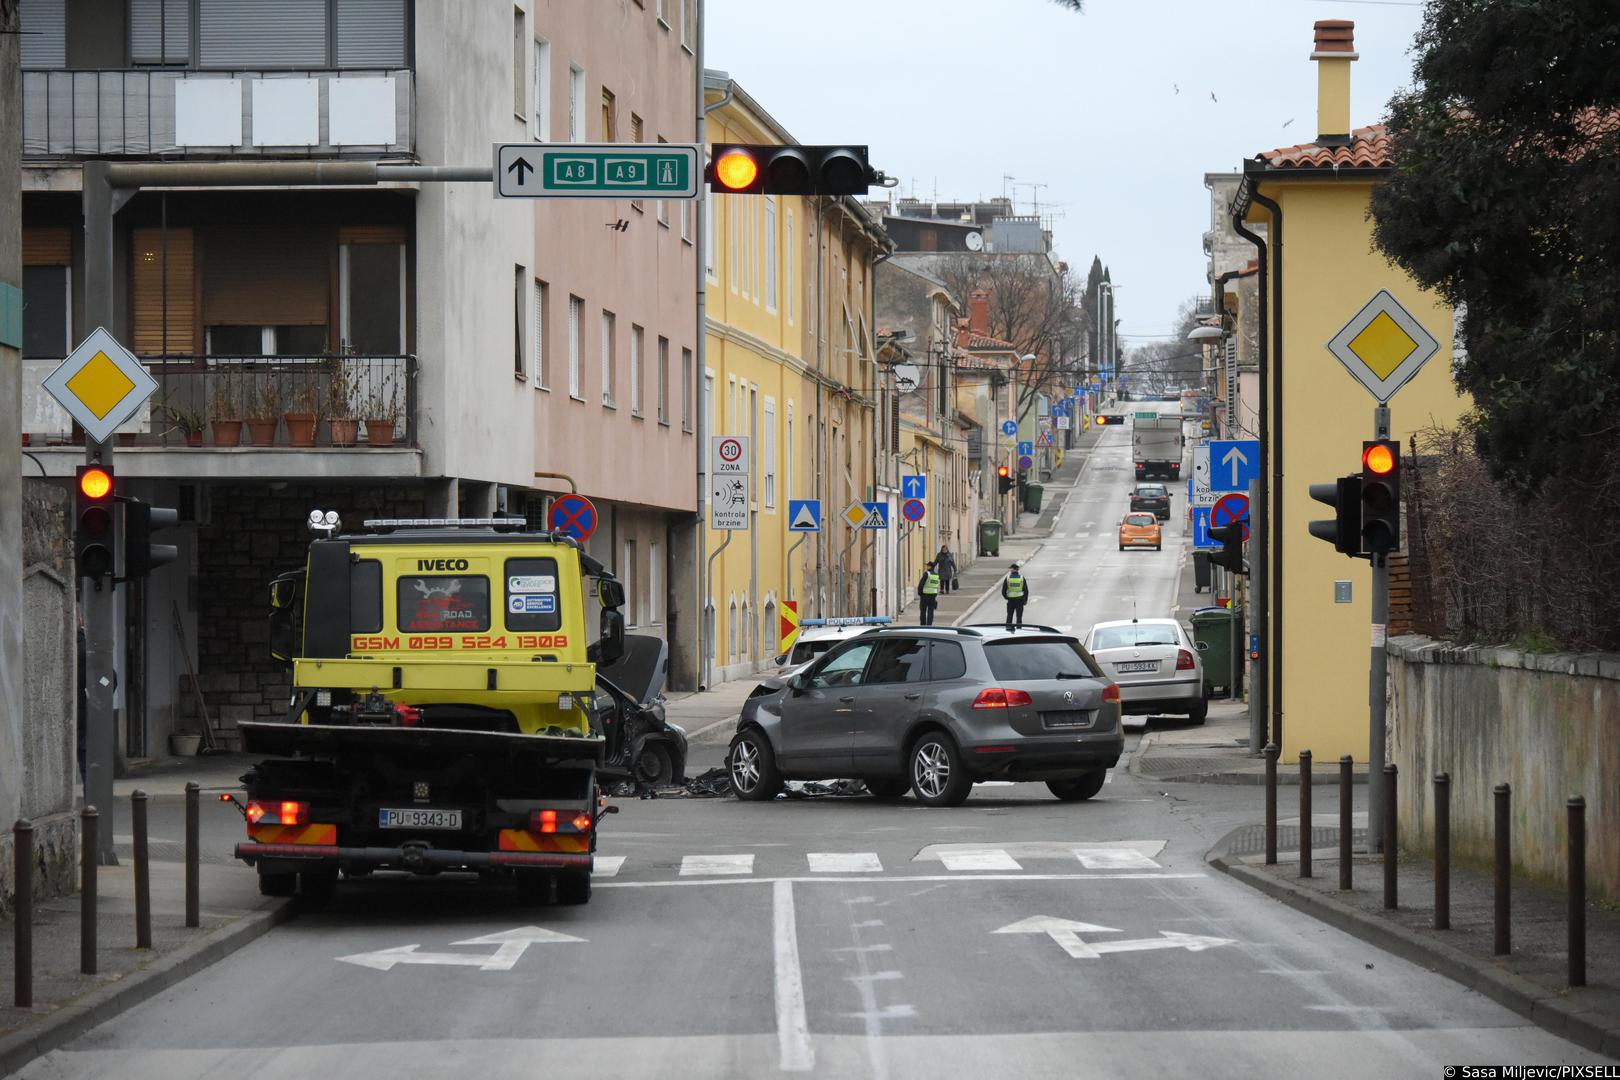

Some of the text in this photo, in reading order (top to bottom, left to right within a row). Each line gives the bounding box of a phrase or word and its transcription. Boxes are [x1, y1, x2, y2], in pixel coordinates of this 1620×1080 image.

[724, 445, 737, 456] 30
[418, 559, 469, 571] IVECO
[441, 610, 472, 618] ROAD
[353, 635, 568, 650] GSM 099 524 1308
[389, 811, 404, 825] PU
